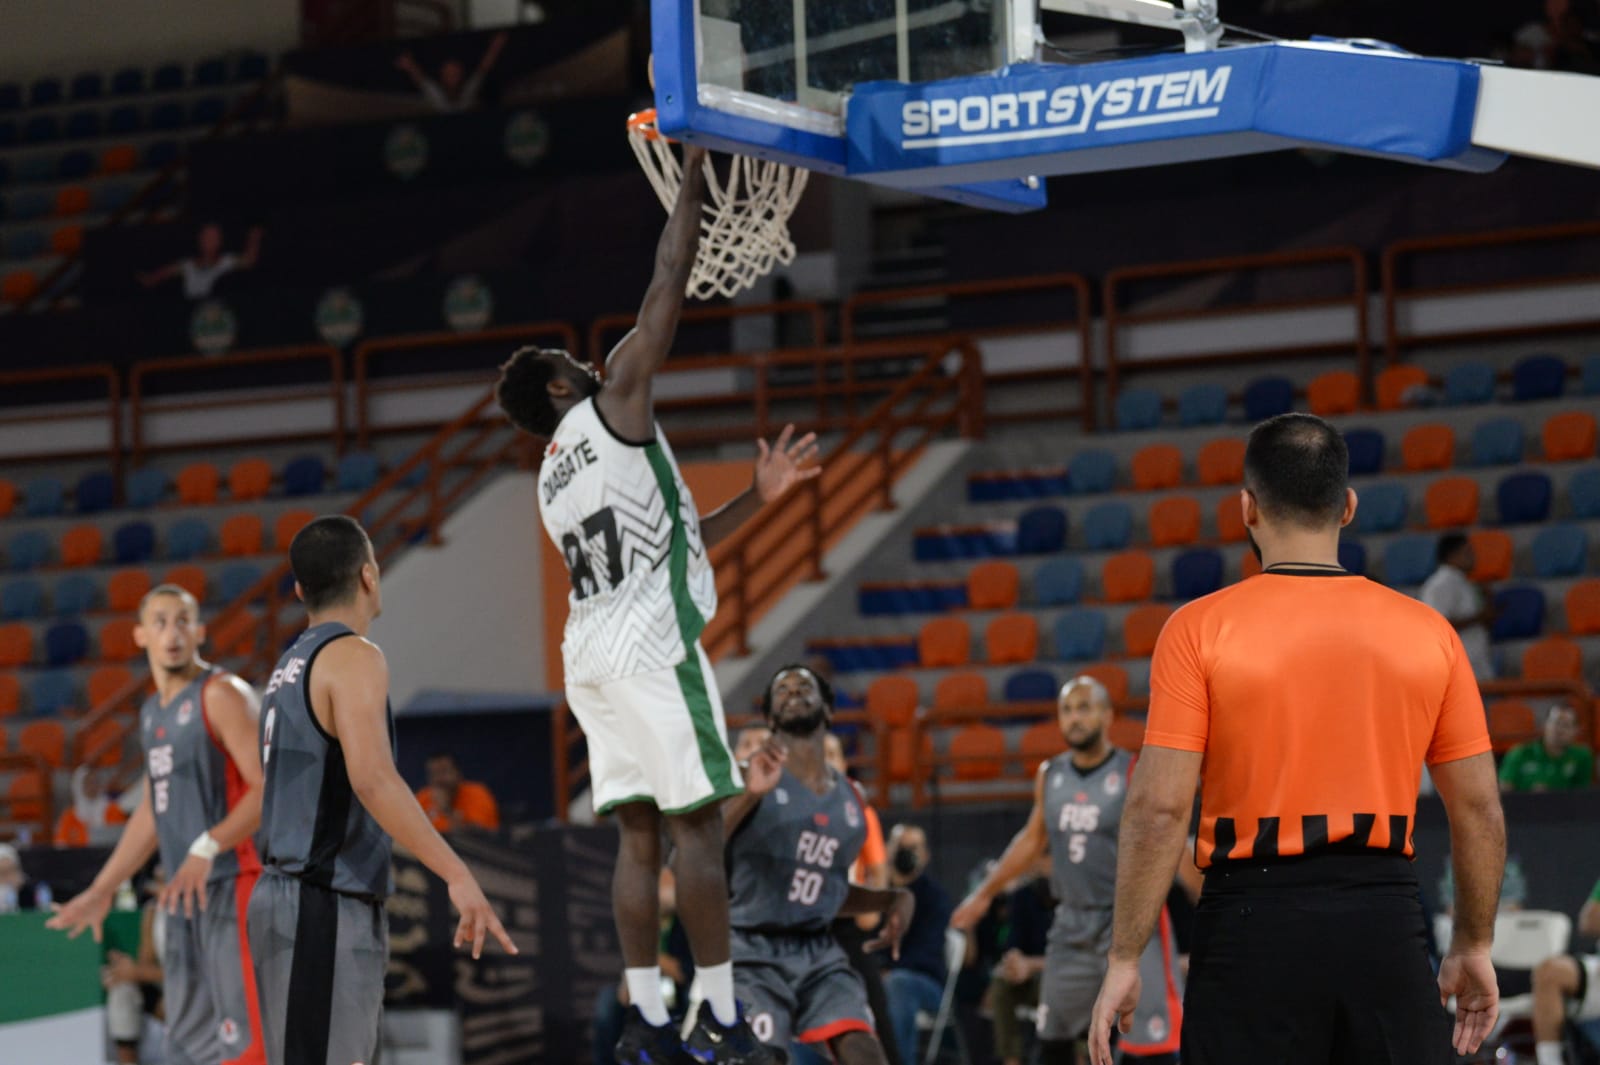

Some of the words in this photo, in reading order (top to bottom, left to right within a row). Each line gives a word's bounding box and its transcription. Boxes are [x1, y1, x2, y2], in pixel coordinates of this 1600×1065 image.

[1059, 803, 1100, 832] FUS
[796, 830, 839, 868] FUS
[1069, 833, 1087, 864] 5
[788, 868, 824, 905] 50
